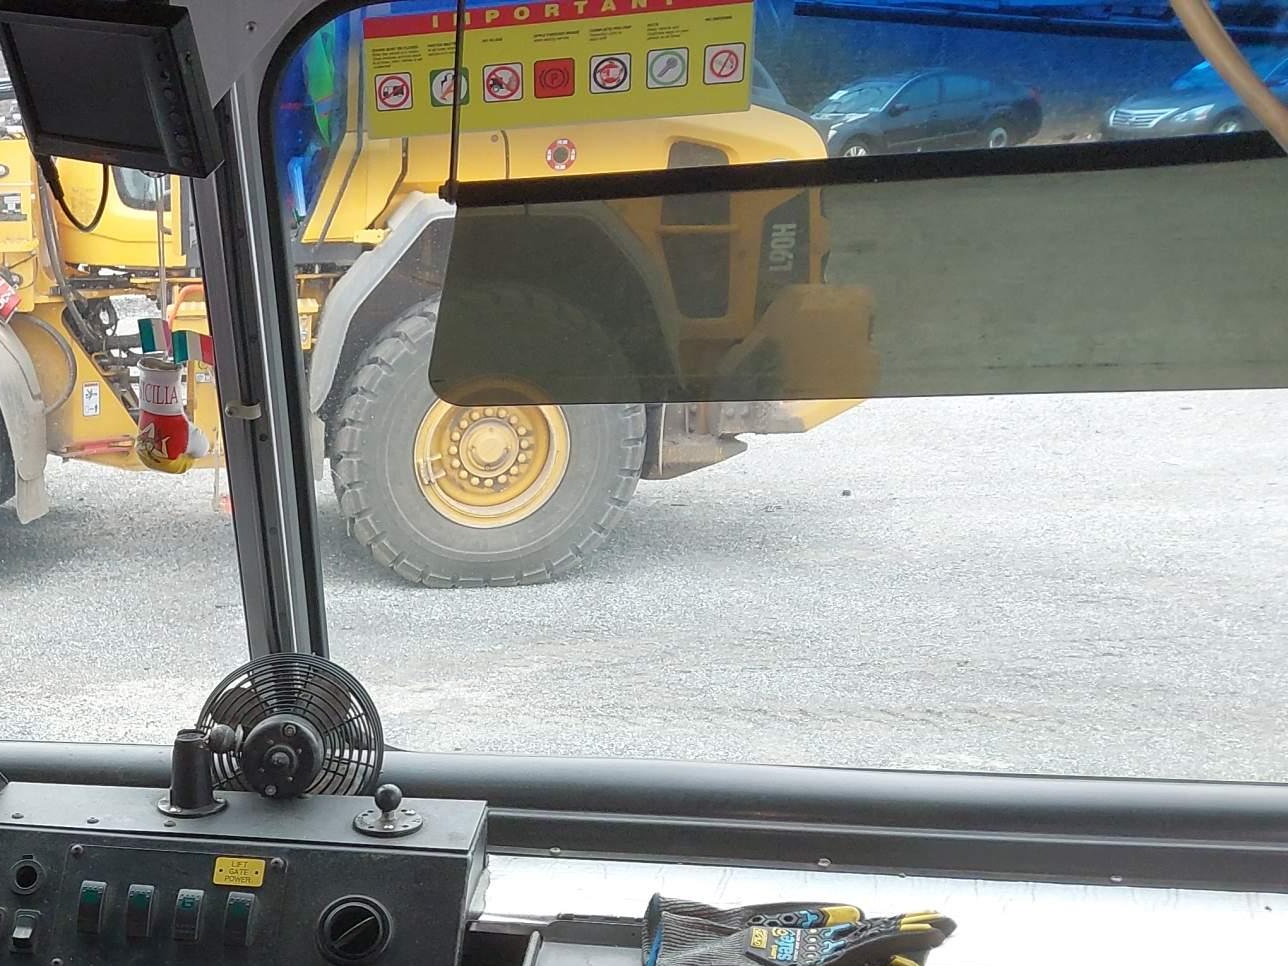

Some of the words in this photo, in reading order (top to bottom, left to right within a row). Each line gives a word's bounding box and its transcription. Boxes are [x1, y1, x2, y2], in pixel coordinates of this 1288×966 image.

[768, 223, 797, 272] L90H
[139, 383, 179, 405] ICILIA
[224, 875, 251, 884] POWER
[229, 868, 249, 876] GATE
